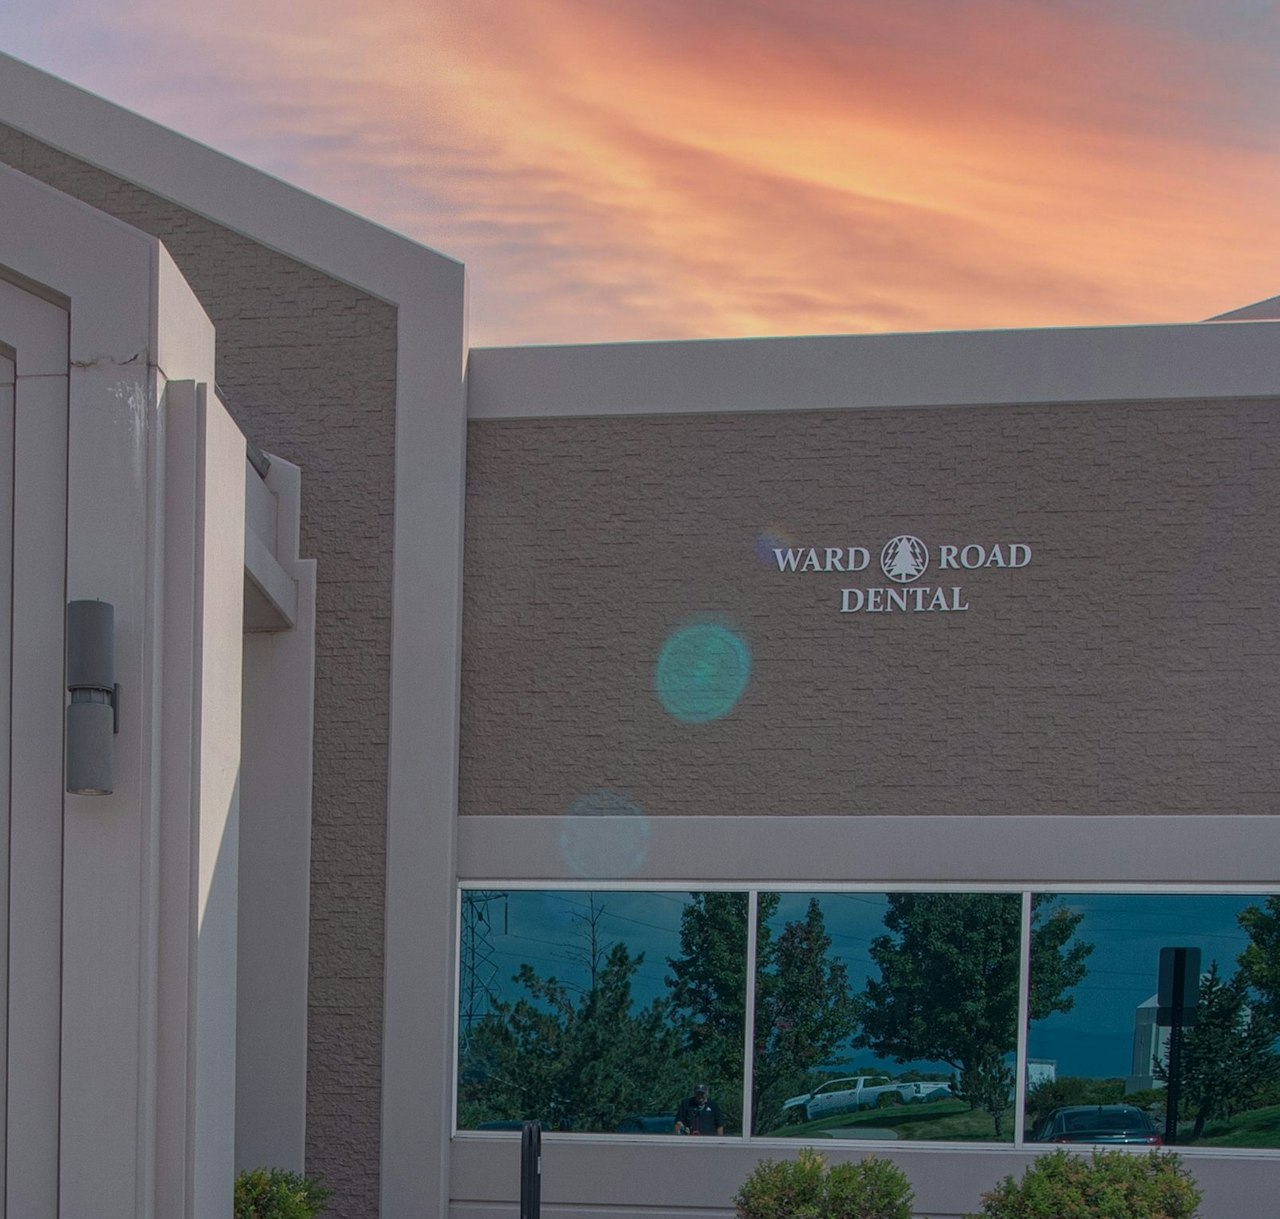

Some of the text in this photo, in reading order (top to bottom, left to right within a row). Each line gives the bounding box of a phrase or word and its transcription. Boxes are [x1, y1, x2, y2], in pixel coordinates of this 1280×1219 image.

[773, 544, 1032, 572] WARD ROAD
[840, 587, 969, 613] DENTAL
